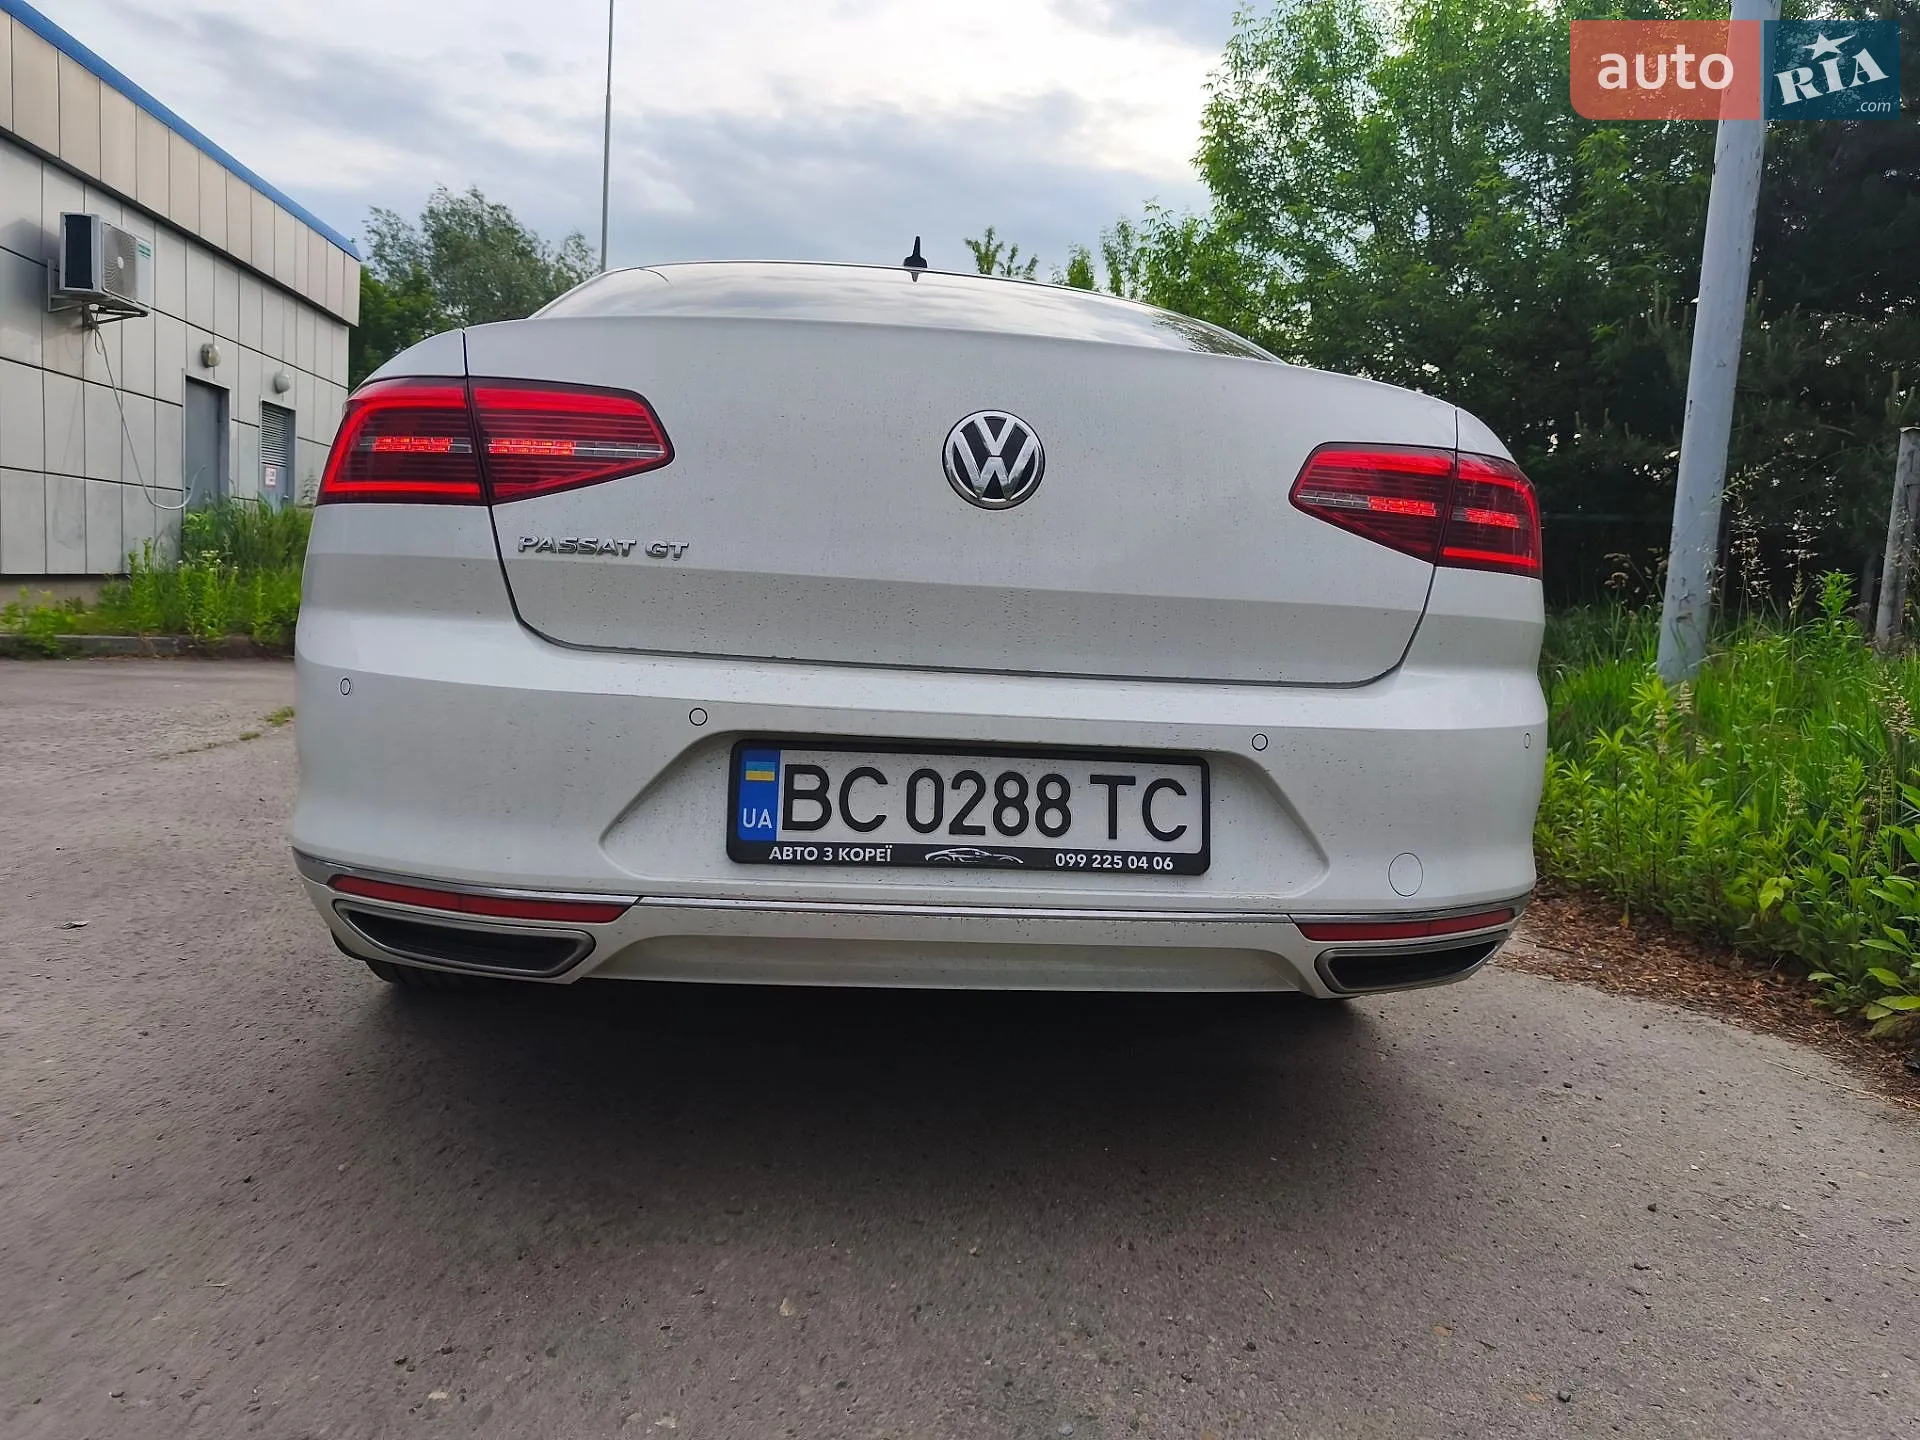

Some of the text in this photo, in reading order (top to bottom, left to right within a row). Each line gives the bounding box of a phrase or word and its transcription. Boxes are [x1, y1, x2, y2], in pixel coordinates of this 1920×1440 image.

[518, 535, 690, 561] PASSAT GT
[781, 763, 1188, 842] BC 0288 TC
[742, 808, 773, 829] UA
[768, 846, 818, 861] АВТО
[838, 845, 893, 862] КОРЕЇ
[1055, 853, 1174, 870] 099 225 04 06
